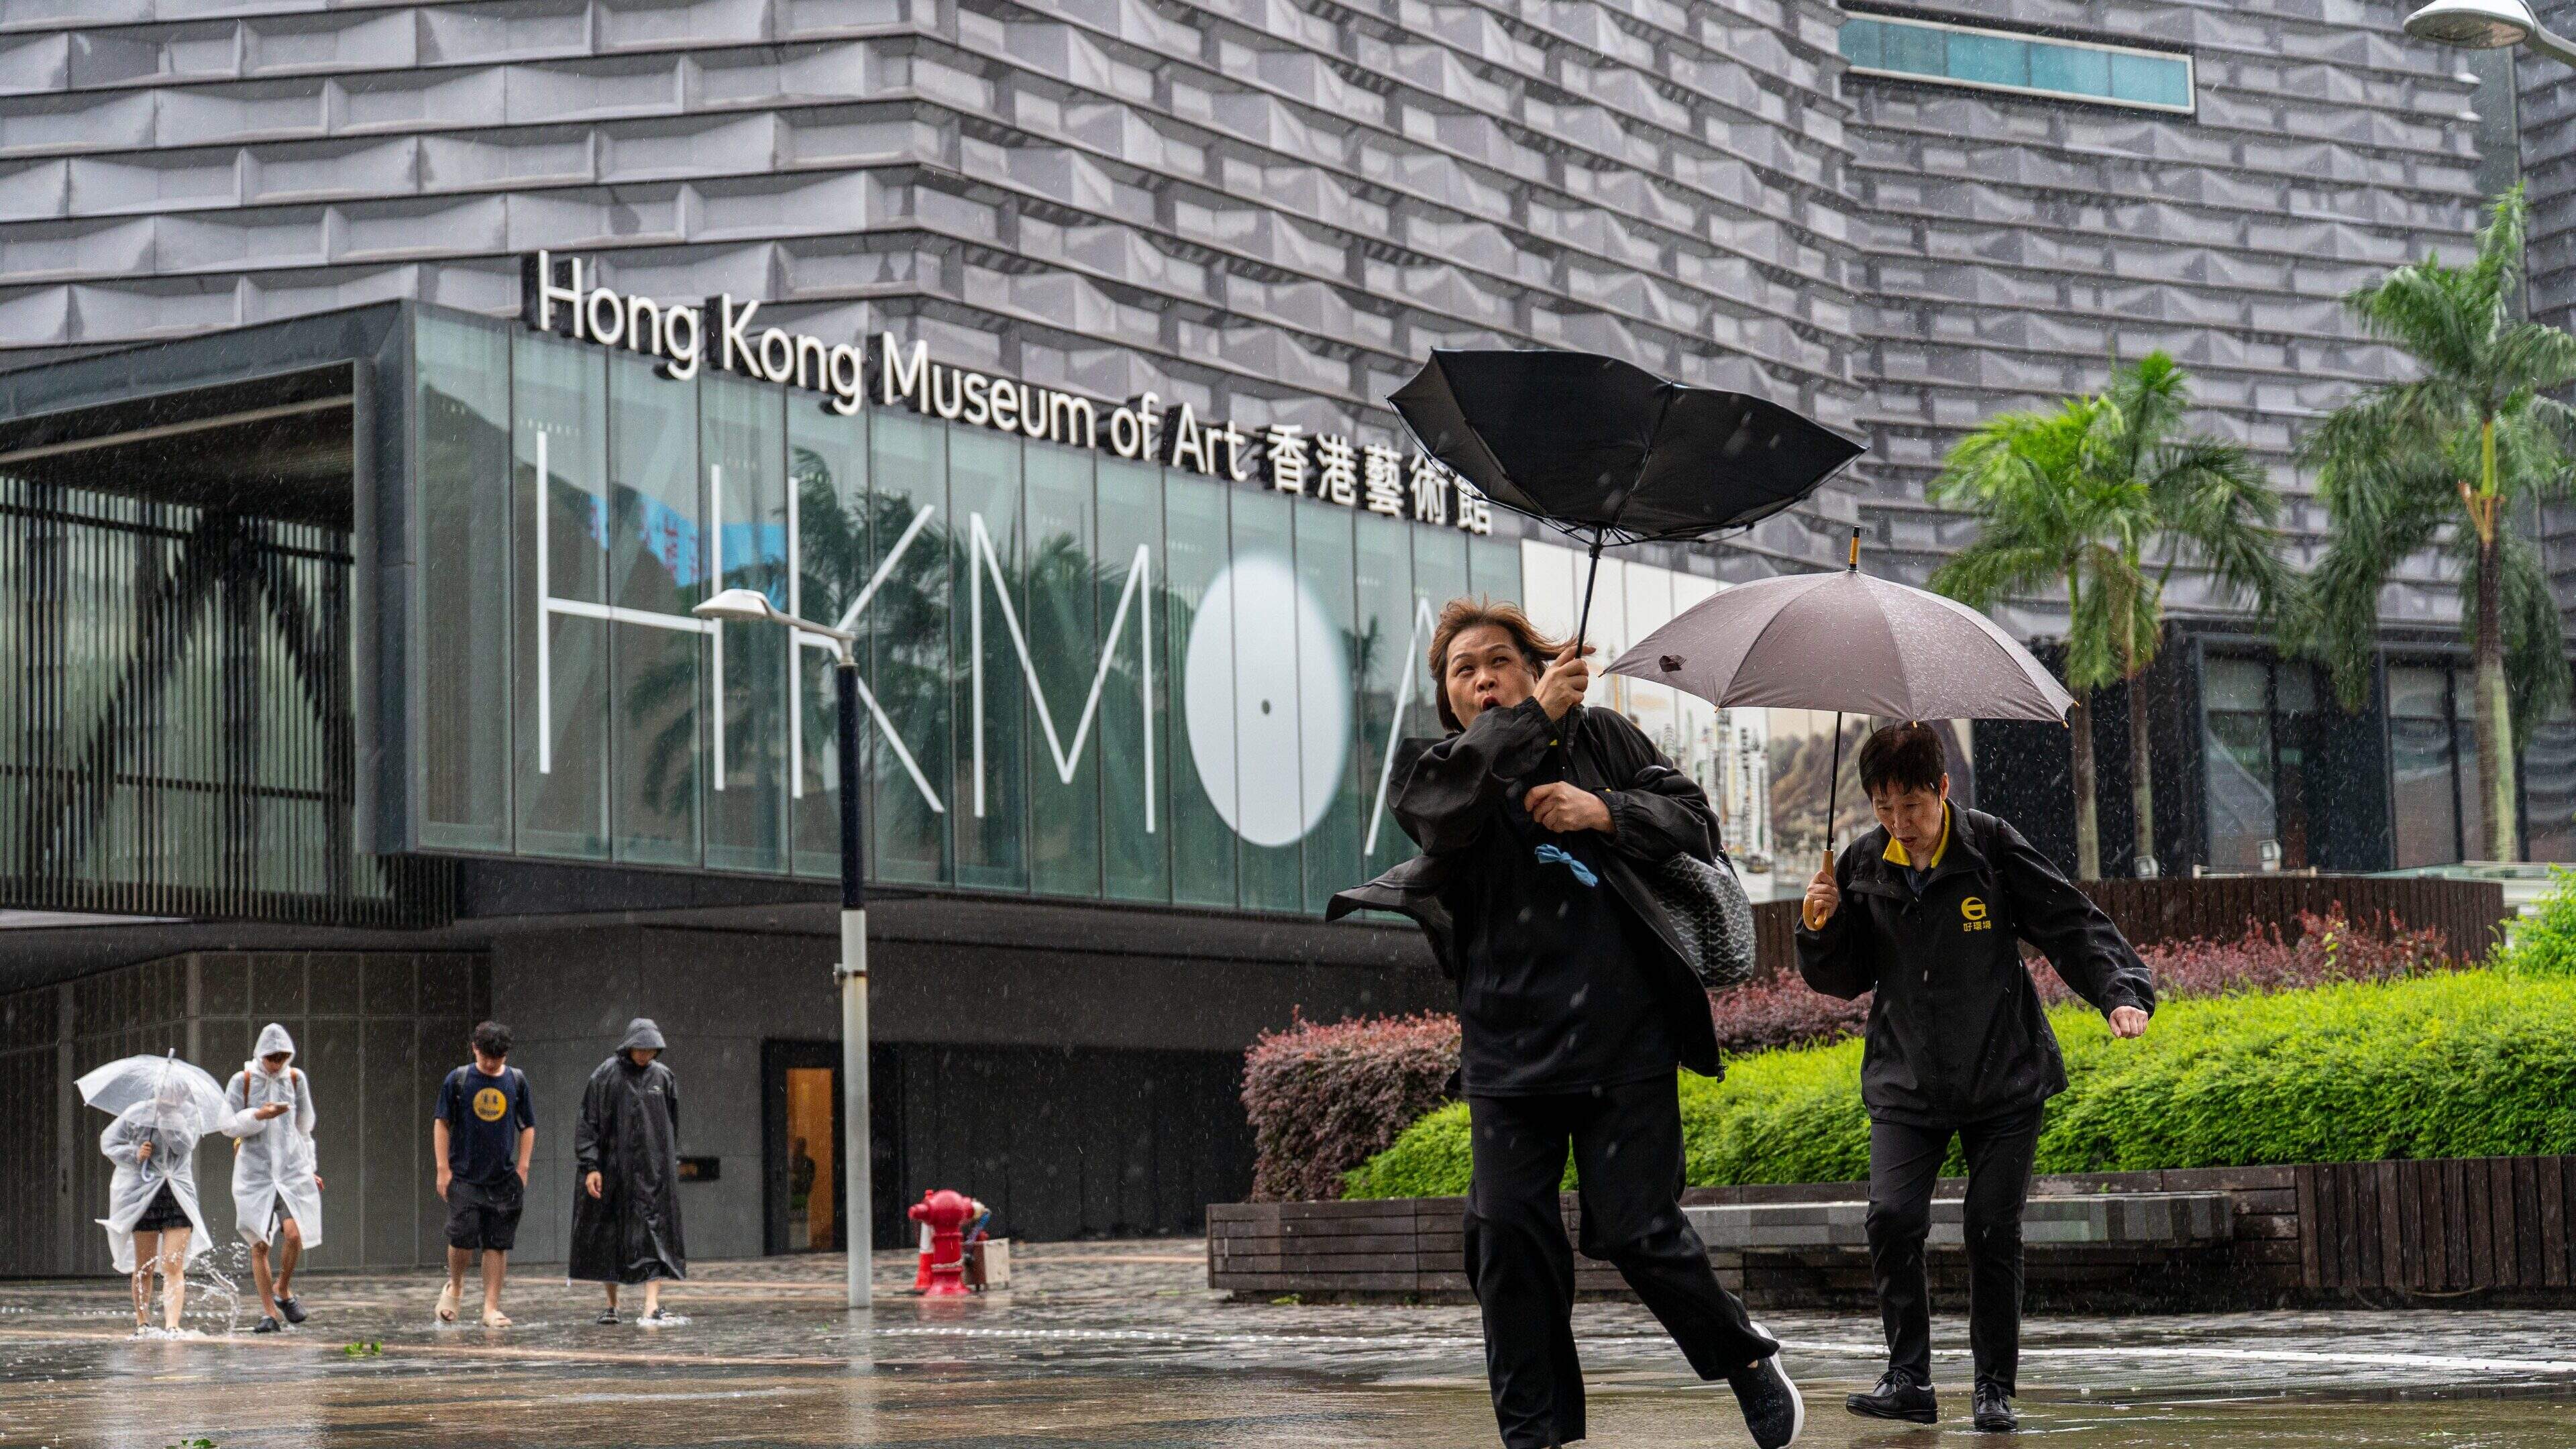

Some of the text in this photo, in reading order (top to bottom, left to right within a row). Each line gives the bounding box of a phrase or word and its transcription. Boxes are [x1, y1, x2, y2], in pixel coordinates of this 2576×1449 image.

[539, 250, 1248, 482] Hong Kong Museum of Art
[1266, 424, 1493, 535] 香港藝術館
